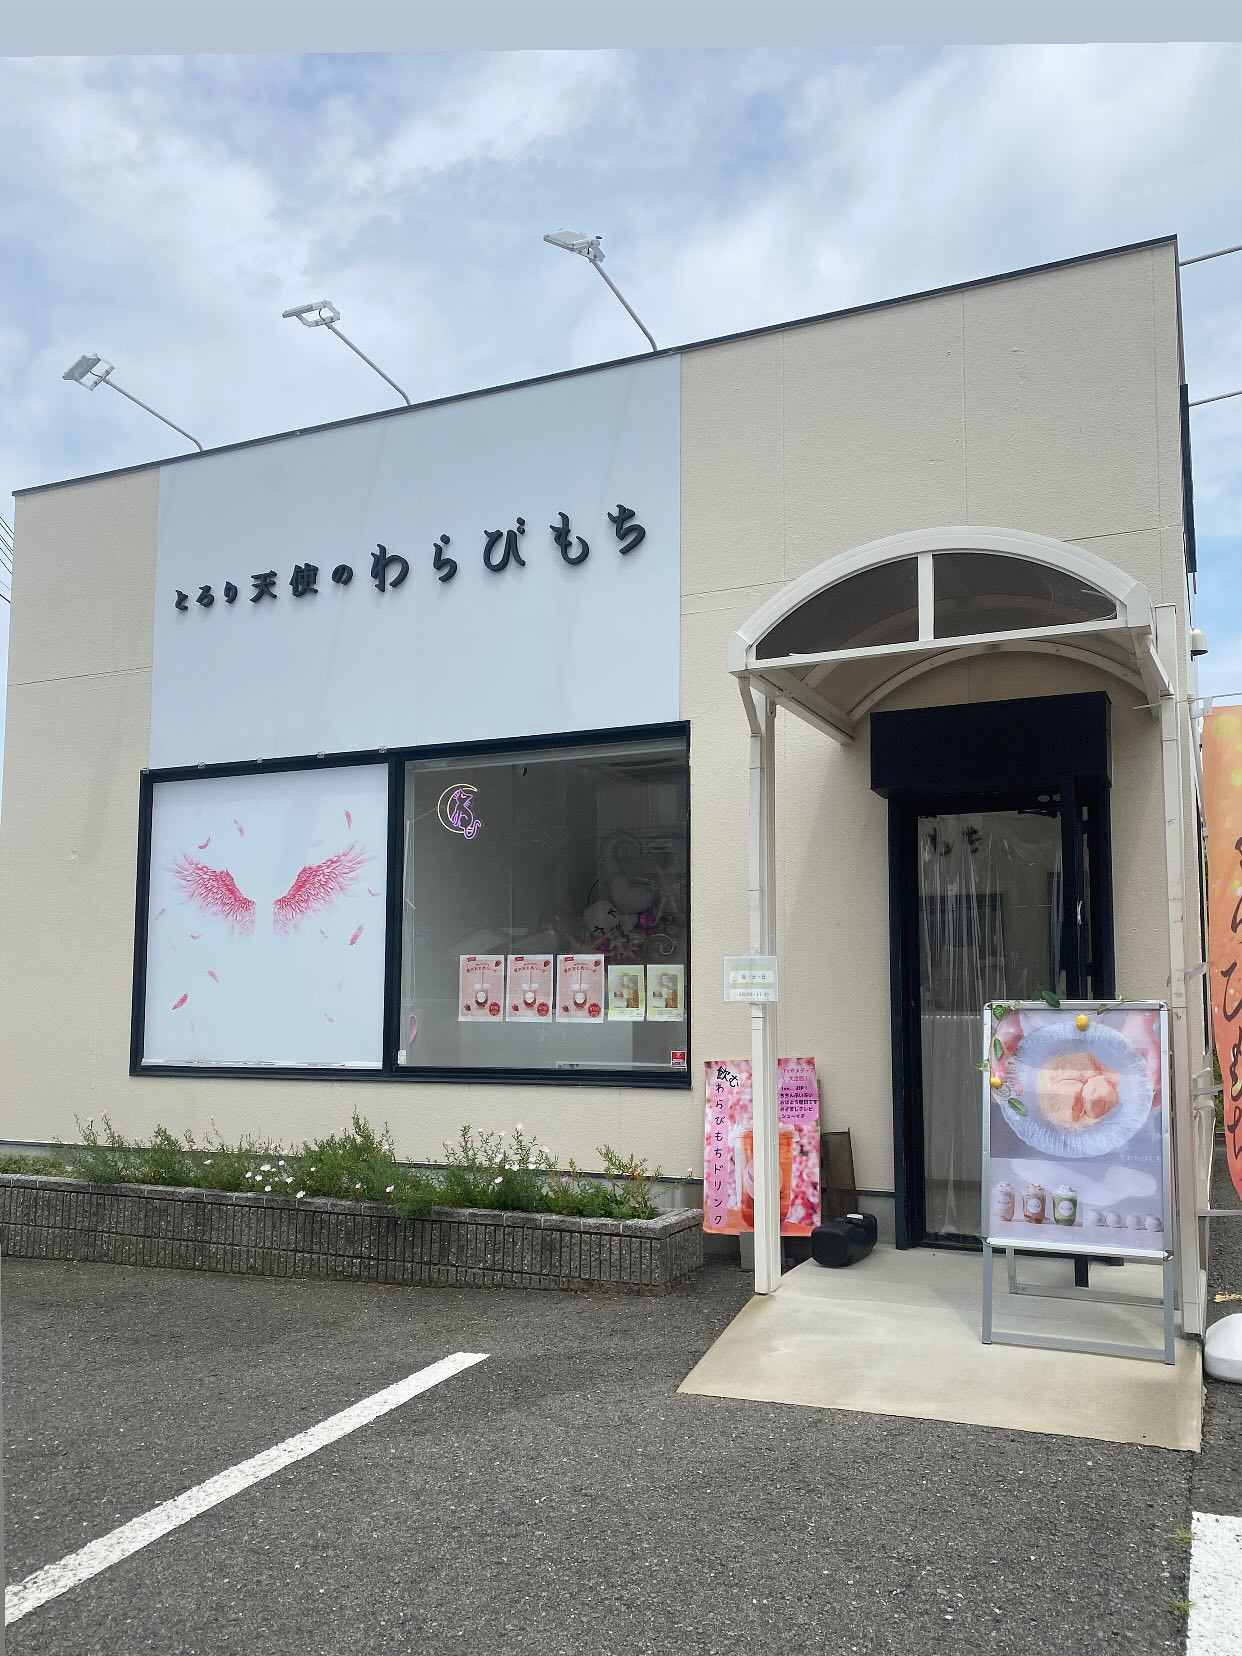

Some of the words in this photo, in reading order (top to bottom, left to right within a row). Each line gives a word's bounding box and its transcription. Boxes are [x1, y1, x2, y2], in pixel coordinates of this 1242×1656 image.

[716, 1065, 740, 1088] 飲む
[713, 1082, 726, 1225] わらびもちドリンク
